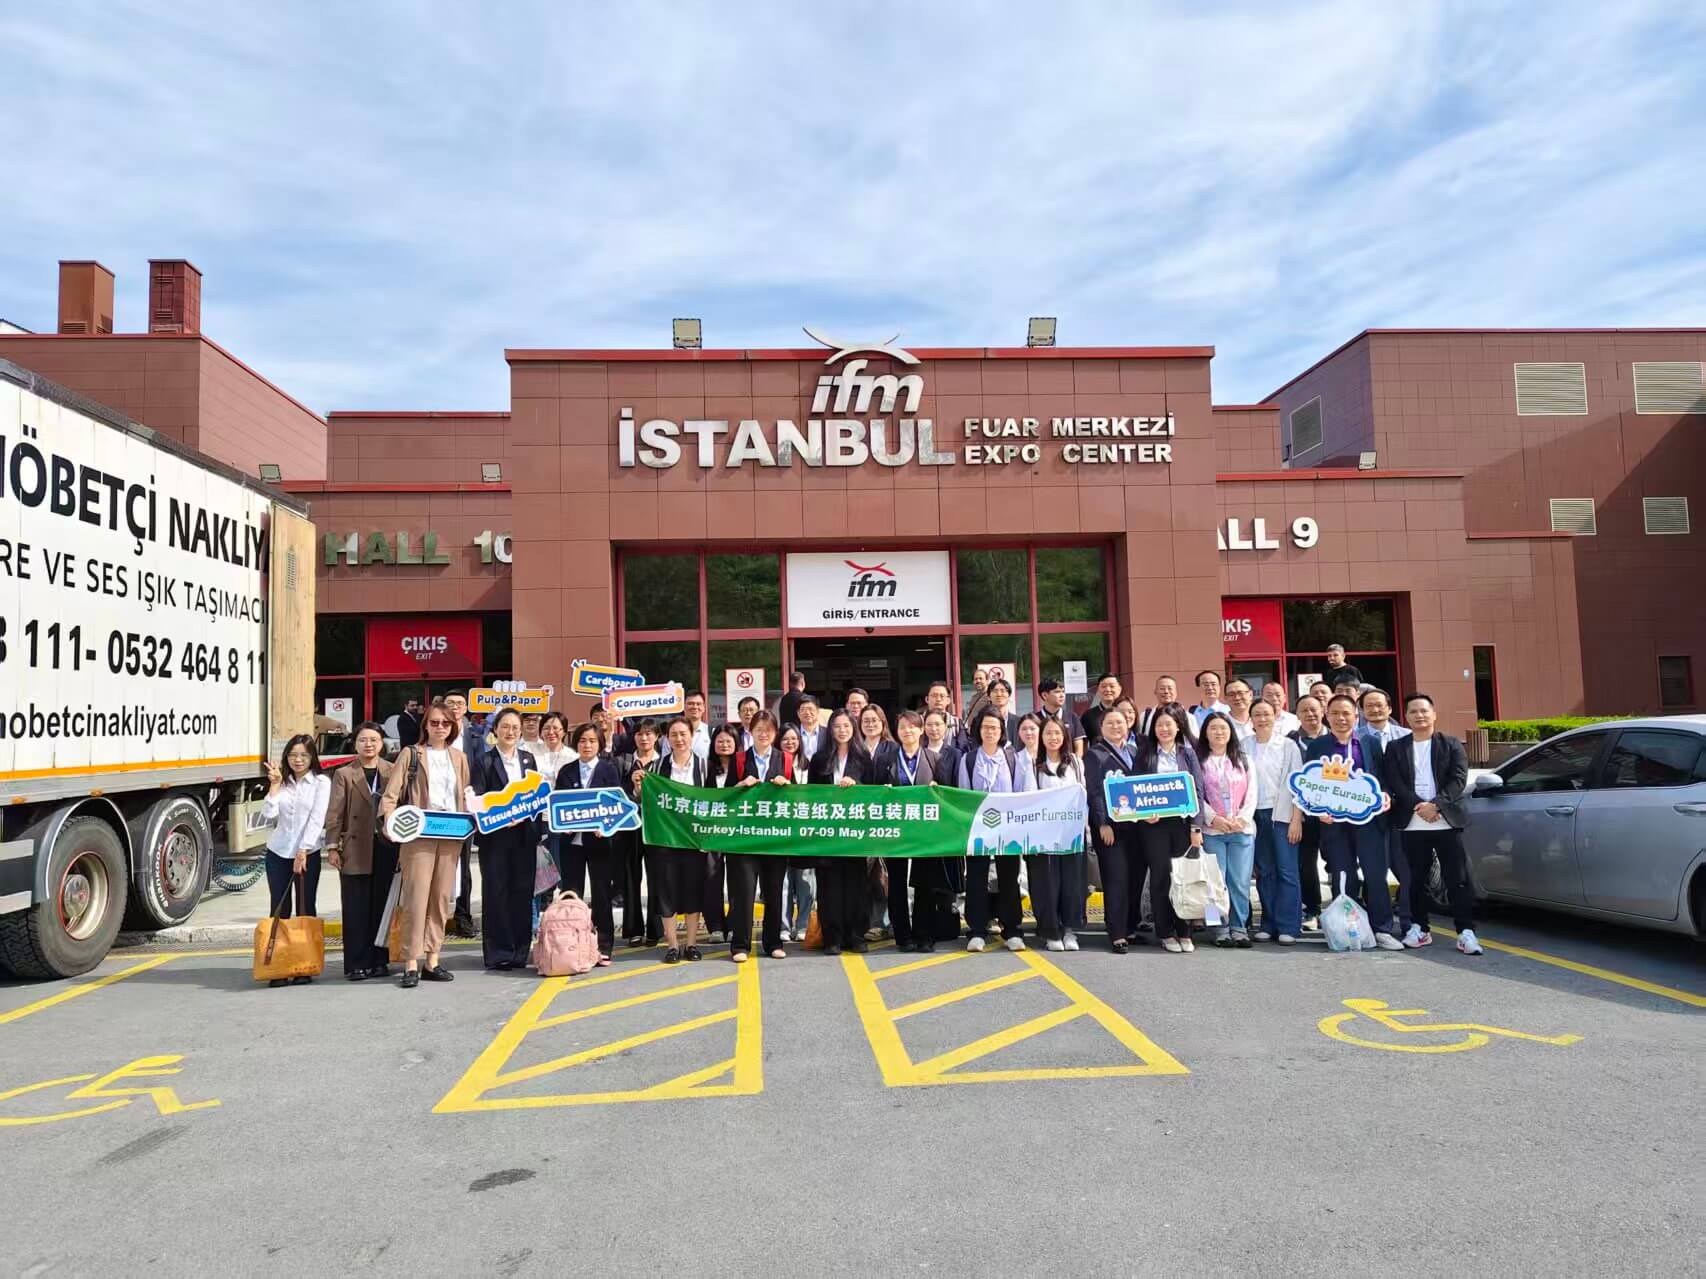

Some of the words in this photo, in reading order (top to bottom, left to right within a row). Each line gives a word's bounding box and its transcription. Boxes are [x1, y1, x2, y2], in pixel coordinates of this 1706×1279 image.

[811, 359, 924, 413] ifm
[964, 417, 1040, 438] FUAR
[1051, 412, 1175, 437] MERKEZİ
[618, 407, 956, 468] İSTANBUL
[965, 443, 1041, 464] EXPO
[1062, 443, 1173, 464] CENTER
[1292, 517, 1319, 548] 9
[325, 532, 451, 565] HALL
[43, 548, 75, 588] VE
[86, 558, 128, 598] SES
[137, 570, 176, 611] IŞIK
[848, 573, 897, 598] ifm
[822, 608, 920, 620] GİRİŞ/ENTRANCE
[401, 636, 448, 654] ÇIKIŞ
[107, 630, 173, 678] 0532
[181, 642, 221, 682] 464
[228, 648, 239, 684] 8
[415, 652, 433, 660] EXIT
[477, 694, 542, 707] Pulp&Paper
[616, 695, 675, 708] Corrugated
[1132, 779, 1185, 794] Mideast&
[1298, 777, 1330, 793] Paper
[1332, 785, 1372, 804] Eurasia
[560, 802, 624, 822] Istanbul
[1135, 795, 1169, 808] Africa
[691, 822, 792, 837] Turkey-Istanbul
[799, 826, 835, 837] 07-09
[838, 827, 865, 840] May
[868, 827, 901, 838] 2025
